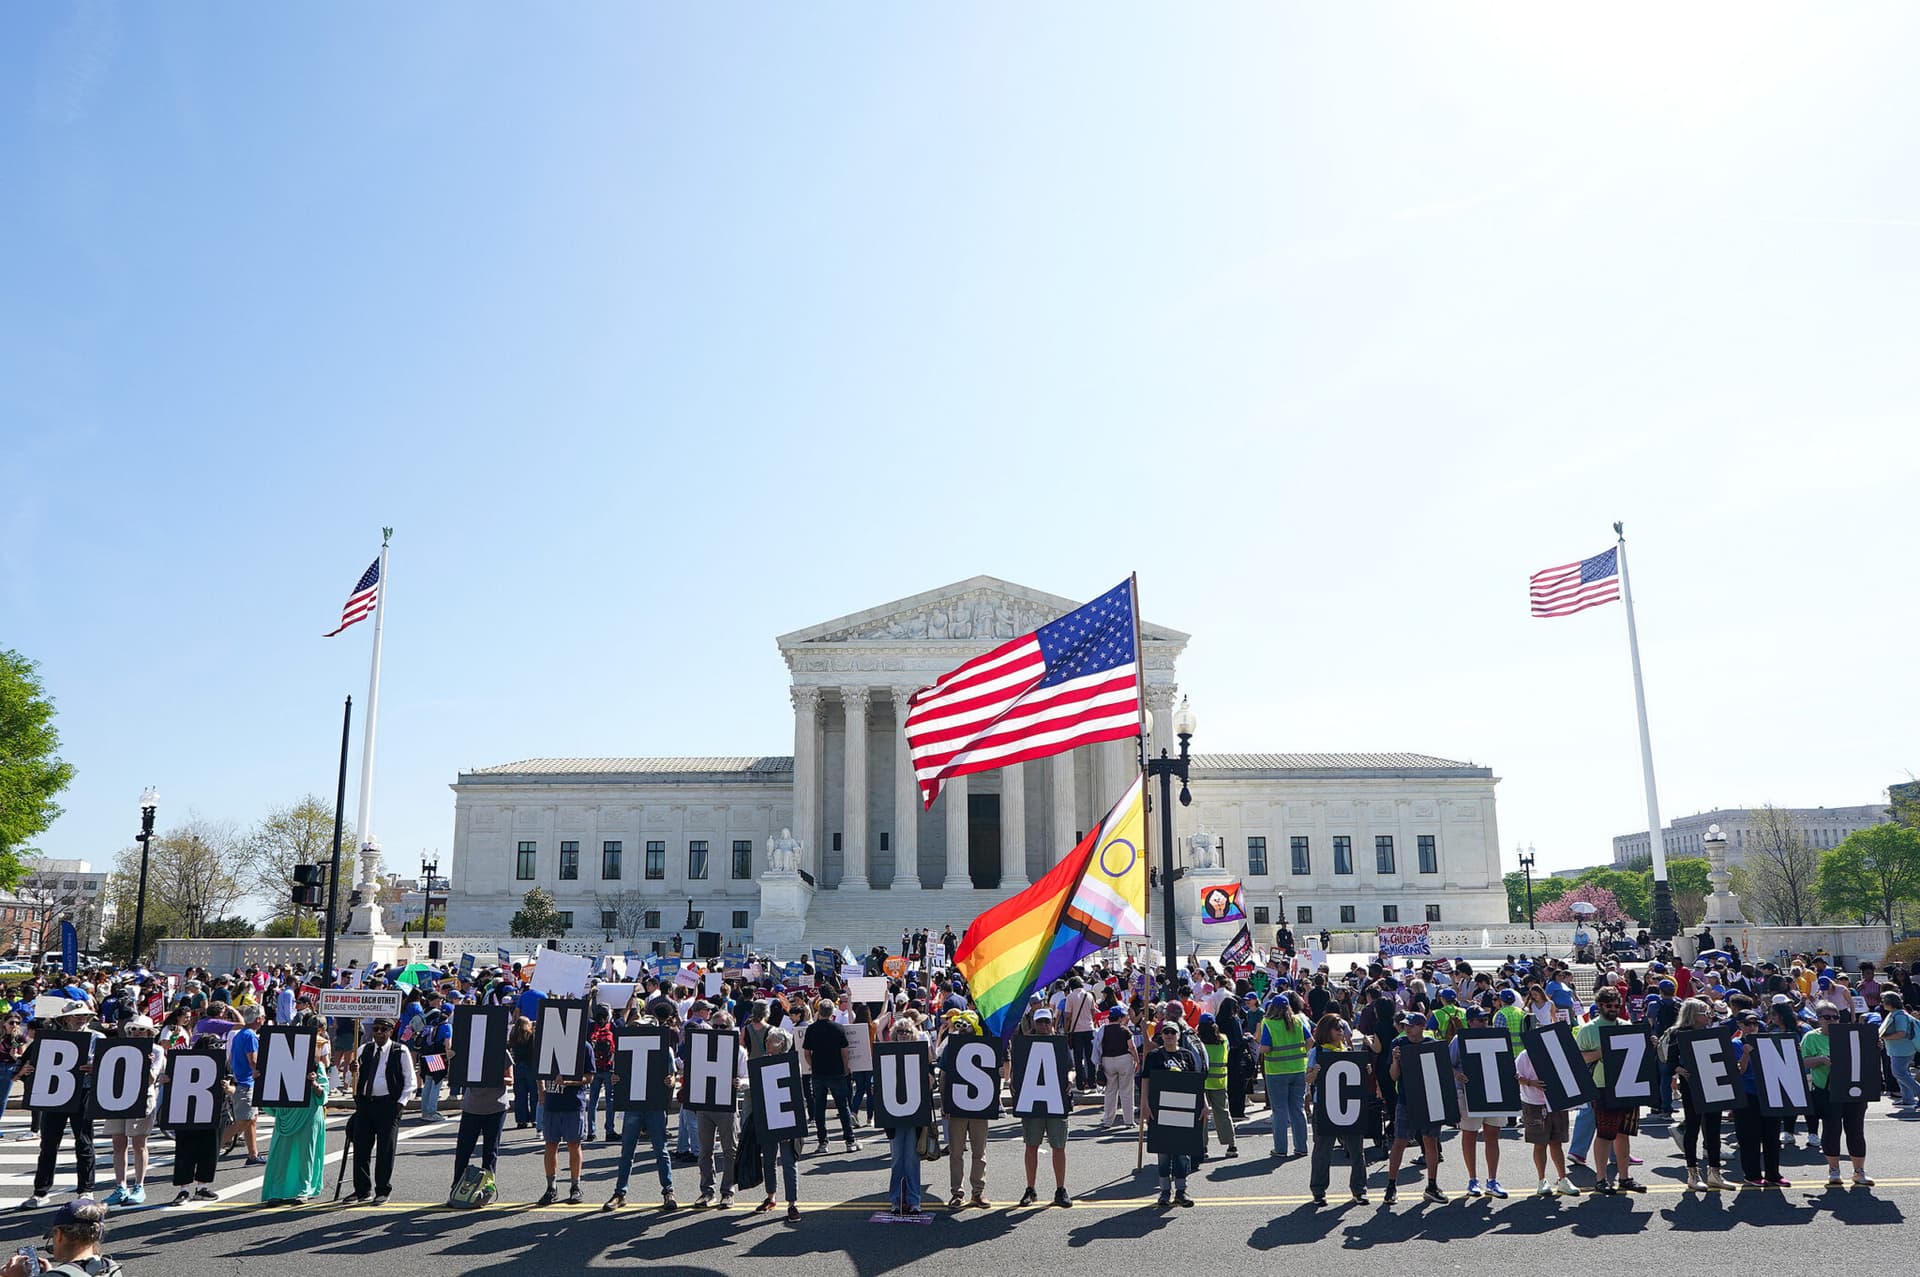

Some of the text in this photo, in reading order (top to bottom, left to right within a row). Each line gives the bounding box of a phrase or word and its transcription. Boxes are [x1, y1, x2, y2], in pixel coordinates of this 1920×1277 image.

[325, 995, 396, 1004] STOP HATING EACH OTHER
[324, 1003, 346, 1011] BECAUSE
[29, 1033, 311, 1124] BORN
[466, 1007, 581, 1082] IN
[618, 1034, 796, 1130] THE
[880, 1042, 1065, 1117] USA
[1325, 1030, 1862, 1126] CITIZEN!
